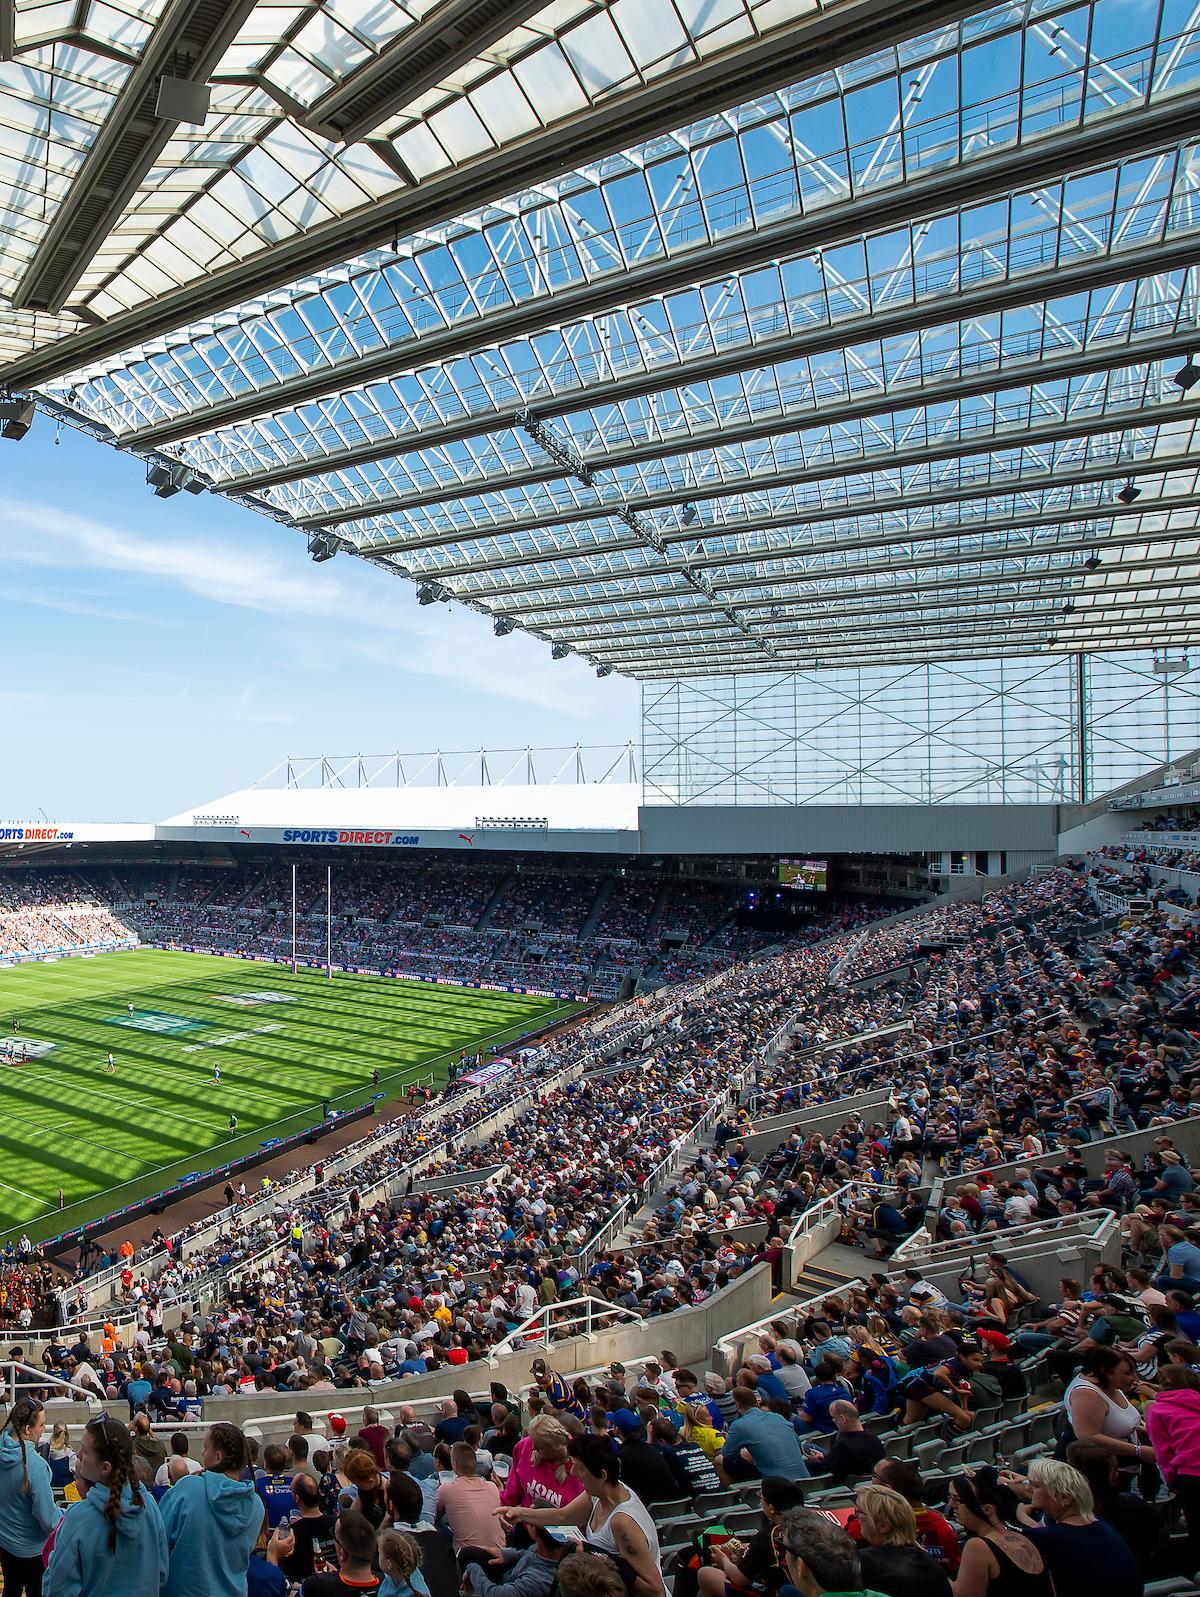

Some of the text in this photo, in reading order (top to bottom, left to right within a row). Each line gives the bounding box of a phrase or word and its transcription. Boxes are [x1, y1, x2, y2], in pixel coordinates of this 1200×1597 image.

[437, 978, 463, 987] BETFRED
[480, 983, 508, 992] BETFRED
[526, 989, 556, 998] BETFRED
[526, 1479, 562, 1508] JOIN
